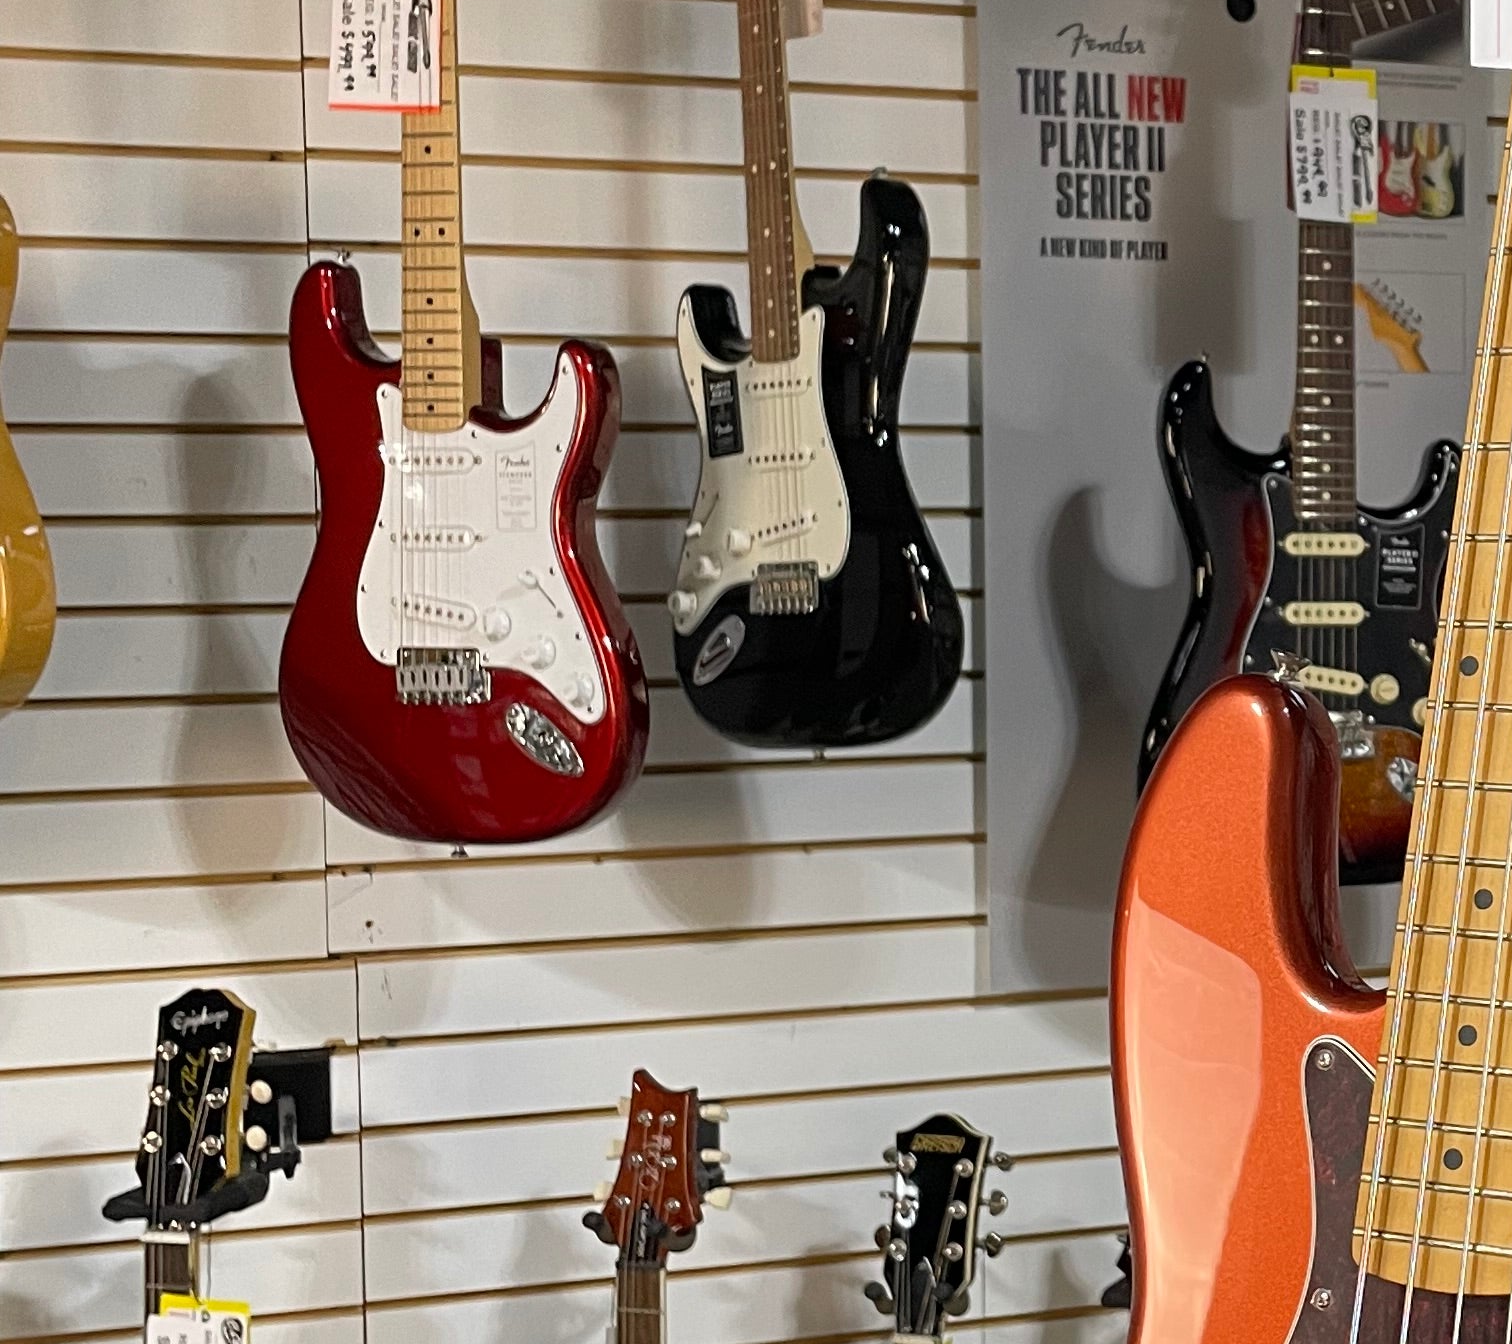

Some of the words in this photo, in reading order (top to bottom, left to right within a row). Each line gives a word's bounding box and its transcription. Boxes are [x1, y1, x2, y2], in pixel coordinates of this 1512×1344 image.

[1056, 22, 1146, 58] Fender
[1016, 67, 1067, 117] THE
[1074, 71, 1121, 120] ALL
[1127, 73, 1187, 124] NEW
[1040, 120, 1141, 172] PLAYER
[1147, 126, 1166, 173] II
[1056, 171, 1152, 223] SERIES
[1040, 236, 1049, 258] A
[1050, 237, 1078, 259] NEW
[1126, 240, 1168, 261] PLAYER
